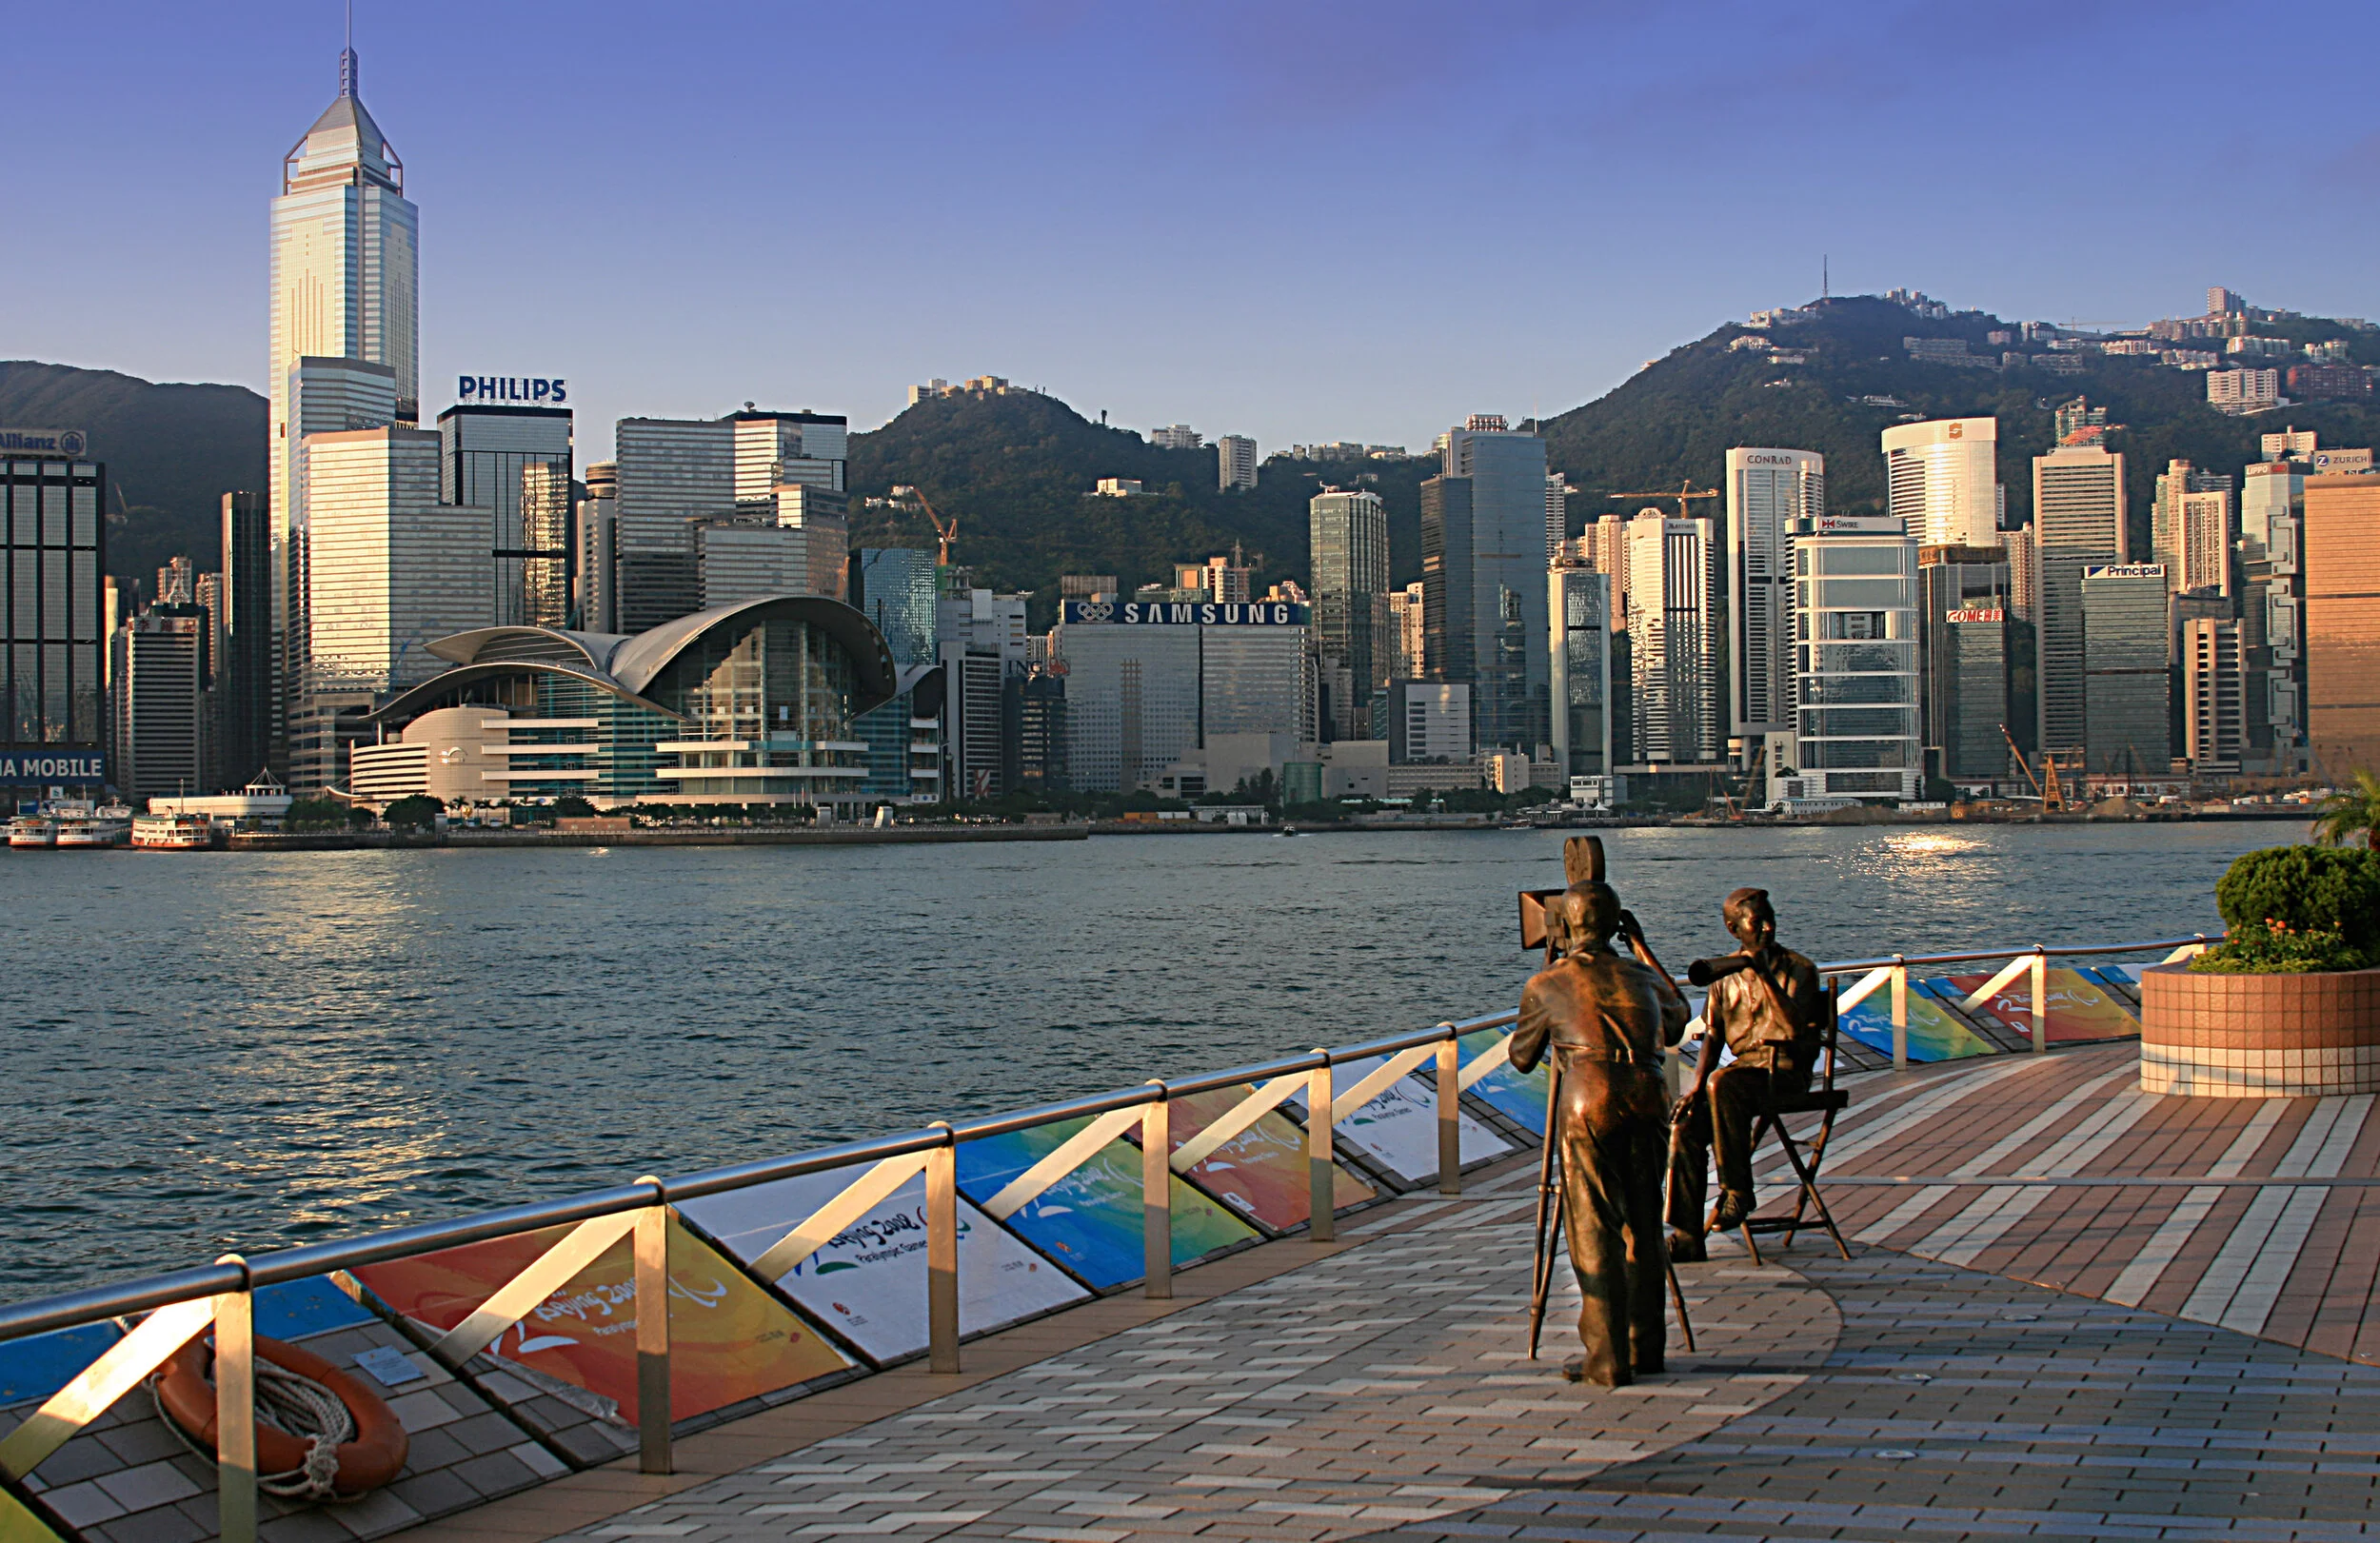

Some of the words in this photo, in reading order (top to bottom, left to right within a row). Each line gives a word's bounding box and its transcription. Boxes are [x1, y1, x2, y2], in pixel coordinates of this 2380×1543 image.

[459, 376, 566, 402] PHILIPS
[1747, 455, 1792, 465] CONRAD
[2247, 465, 2268, 475] LIPPO
[2107, 564, 2161, 578] Principal
[1124, 603, 1288, 624] SAMSUNG
[1948, 610, 1983, 623] GOME
[1006, 660, 1044, 675] ING
[23, 759, 102, 777] MOBILE
[871, 1213, 921, 1236] 2008
[596, 1276, 636, 1304] 200
